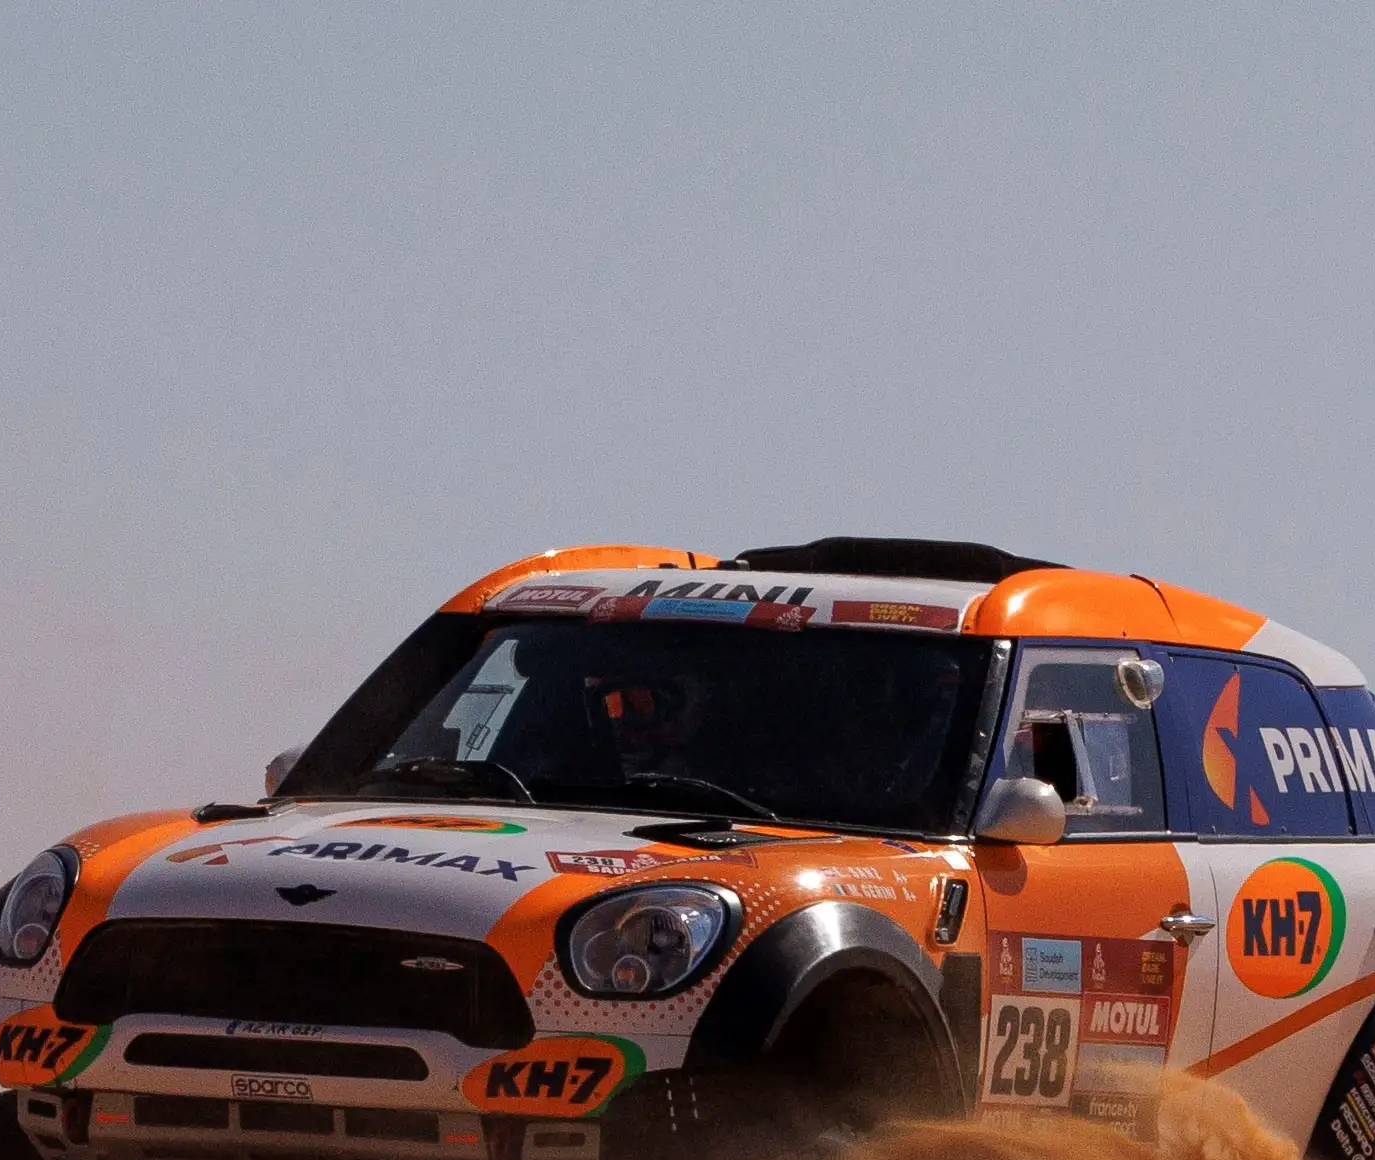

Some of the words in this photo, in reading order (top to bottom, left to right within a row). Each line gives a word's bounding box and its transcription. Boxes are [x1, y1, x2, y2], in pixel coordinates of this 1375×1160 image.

[511, 589, 587, 602] MOTUL
[626, 579, 814, 605] MINI
[267, 842, 538, 882] PRIMAX
[572, 855, 614, 866] 238
[1242, 890, 1322, 964] KH-7
[1089, 1001, 1160, 1036] MOTUL
[990, 1004, 1072, 1098] 238
[235, 1078, 310, 1098] sparco
[486, 1057, 613, 1104] KH-7
[1331, 1119, 1354, 1157] Delta
[1339, 1102, 1373, 1157] RECARO
